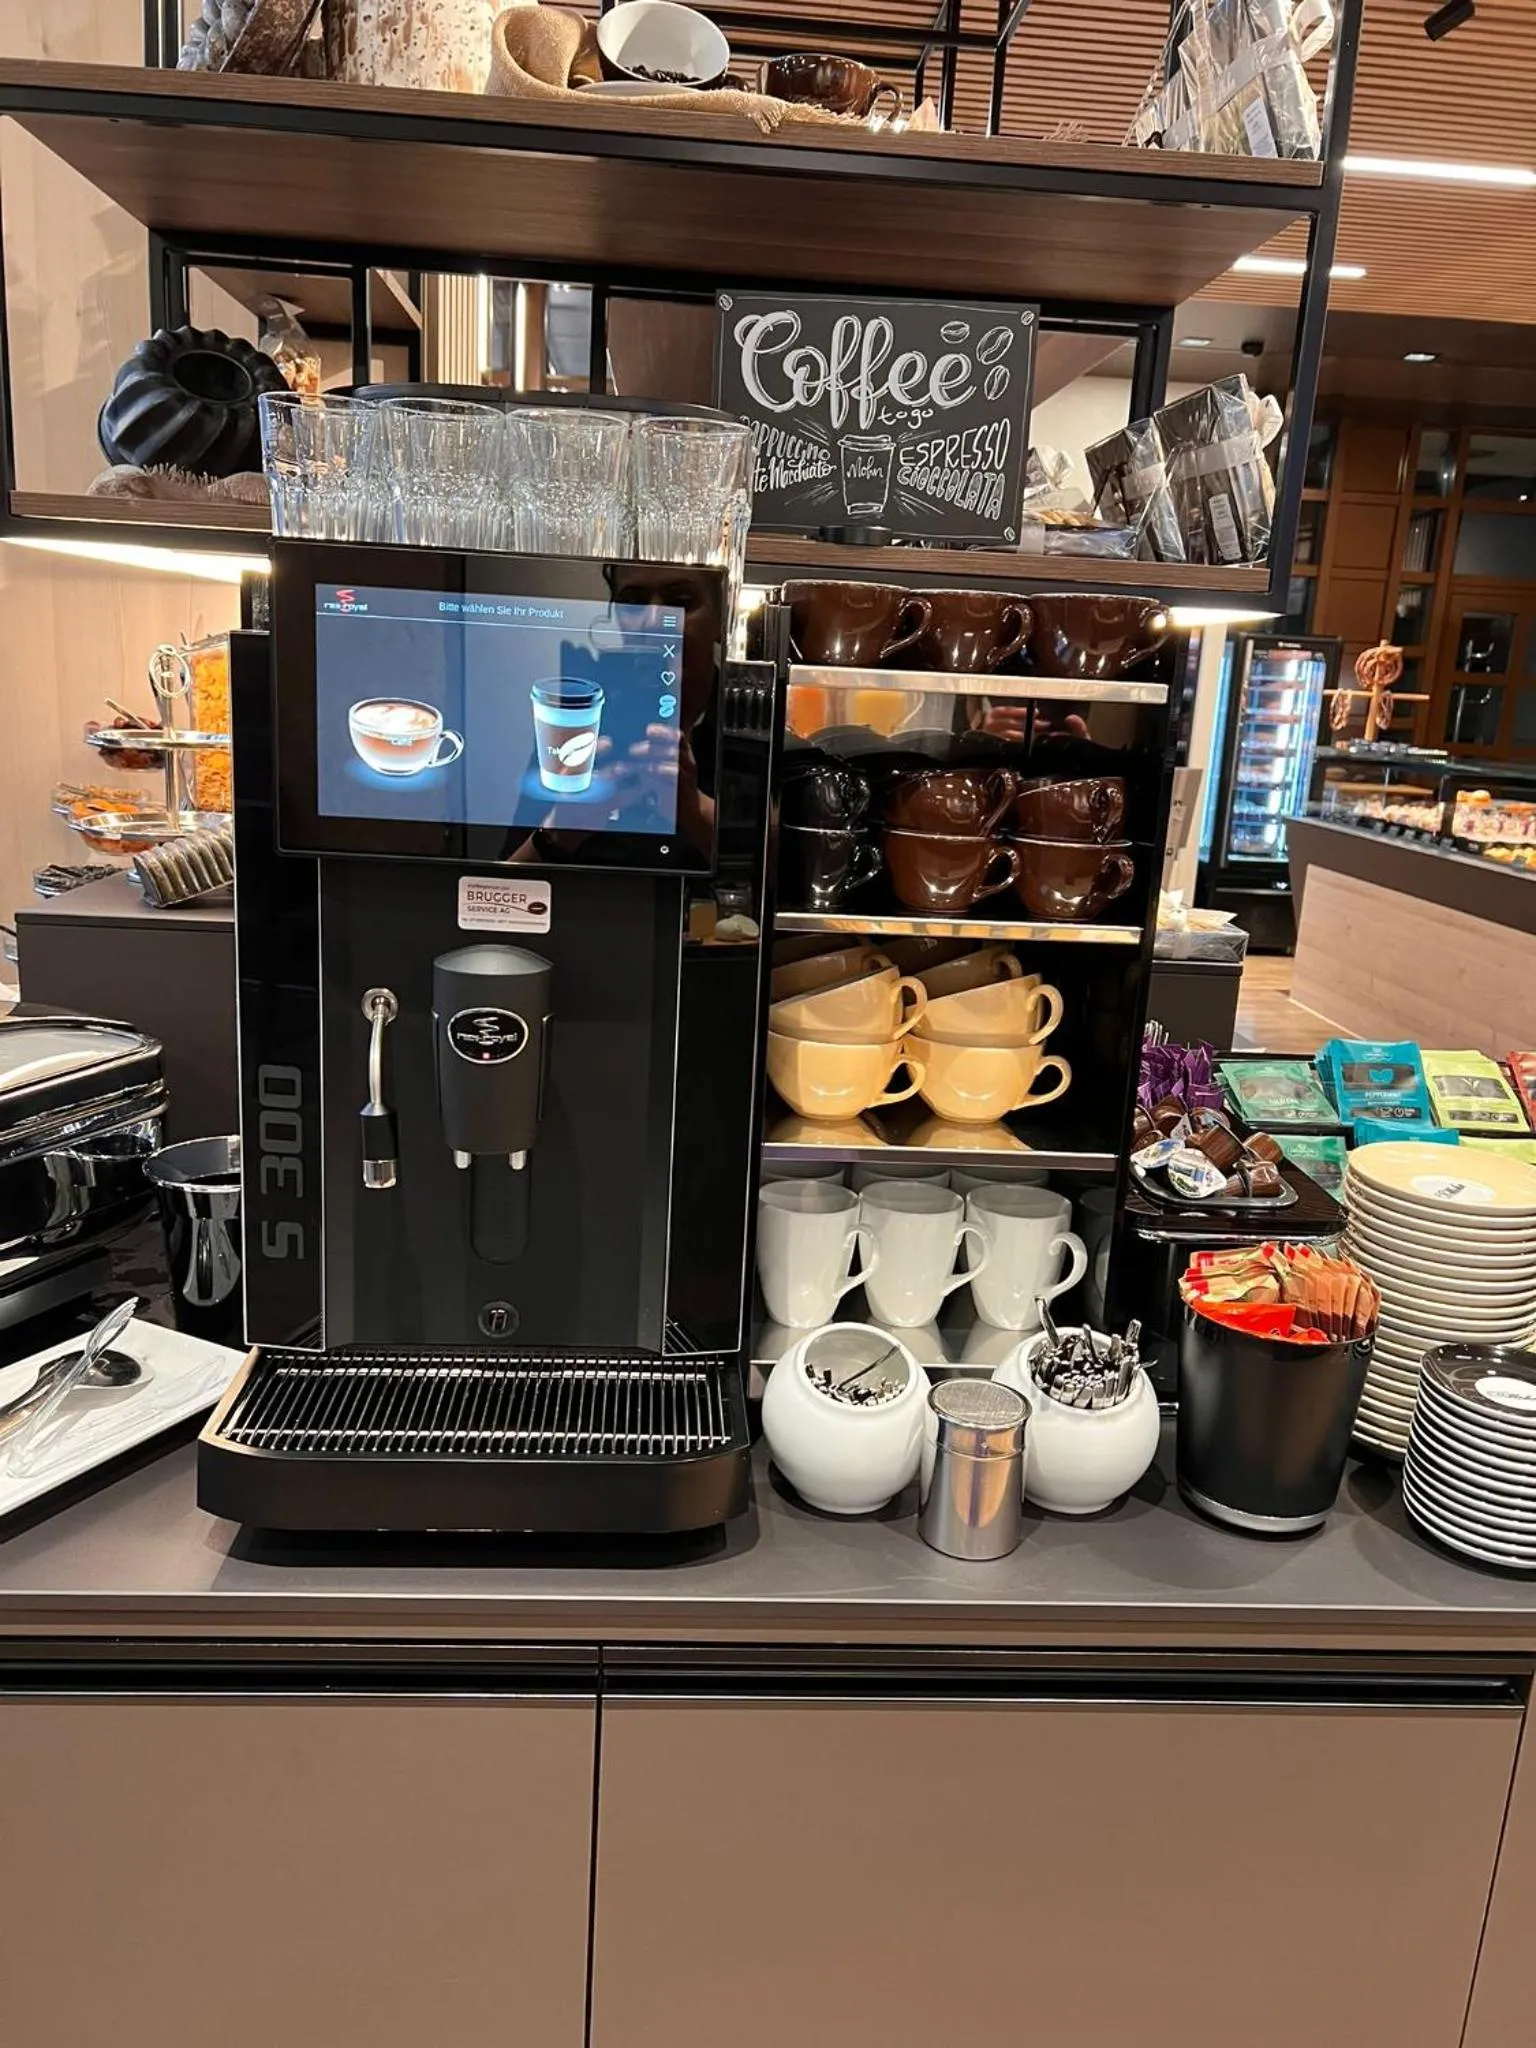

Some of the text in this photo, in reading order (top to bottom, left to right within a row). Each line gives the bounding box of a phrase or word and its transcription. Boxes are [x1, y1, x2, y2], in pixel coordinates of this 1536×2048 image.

[734, 310, 977, 430] Coffee
[899, 417, 1011, 470] ESPRESSO
[438, 601, 565, 619] Bitte wählen Sie Ihr Produkt
[467, 890, 528, 905] BRUGGER
[467, 904, 511, 915] SERVICE AG
[257, 1063, 304, 1260] S 300
